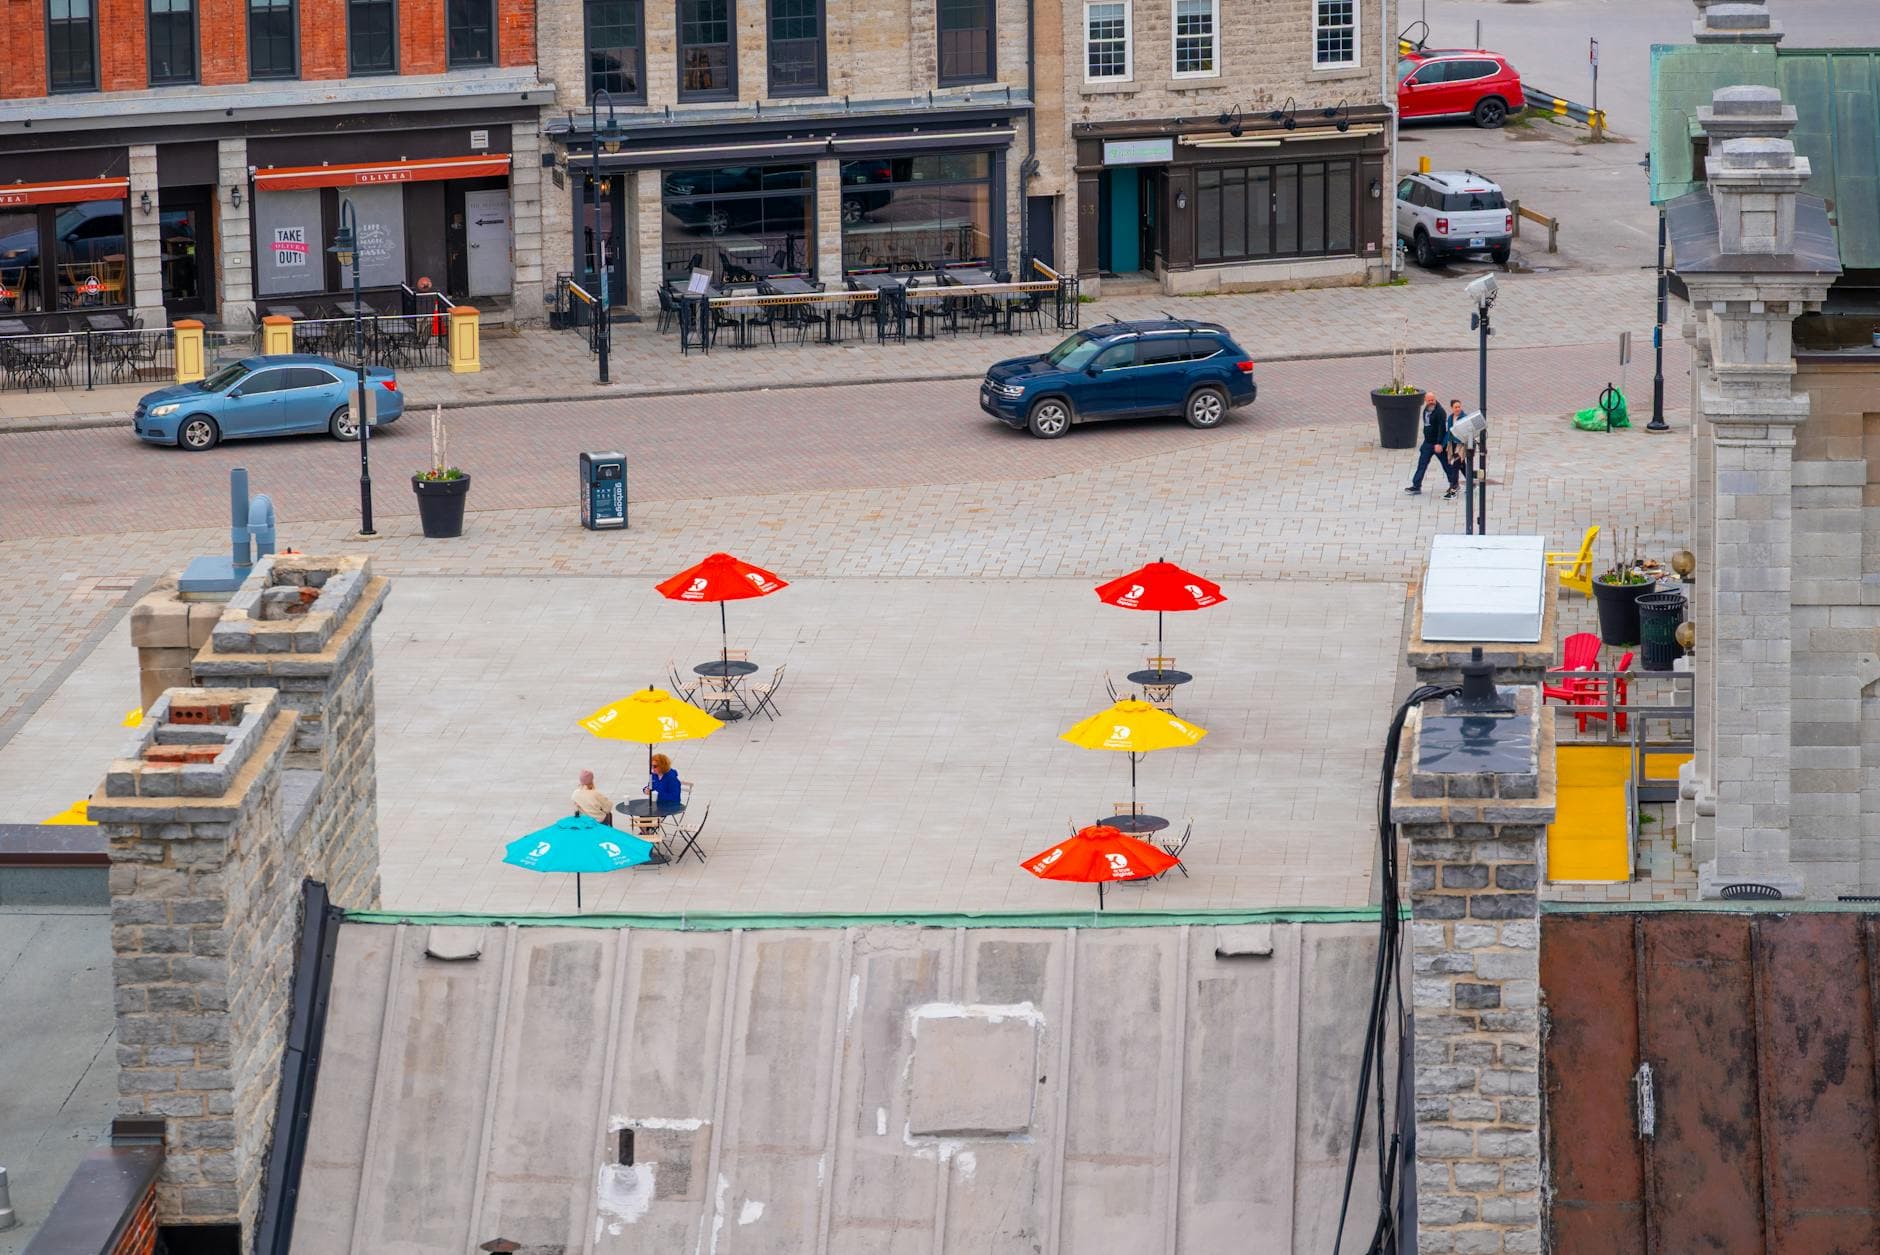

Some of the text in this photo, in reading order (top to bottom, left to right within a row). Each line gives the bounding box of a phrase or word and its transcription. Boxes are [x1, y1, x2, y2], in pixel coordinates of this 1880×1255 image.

[277, 229, 302, 242] TAKE
[279, 251, 302, 264] OUT!
[614, 482, 624, 518] garbage
